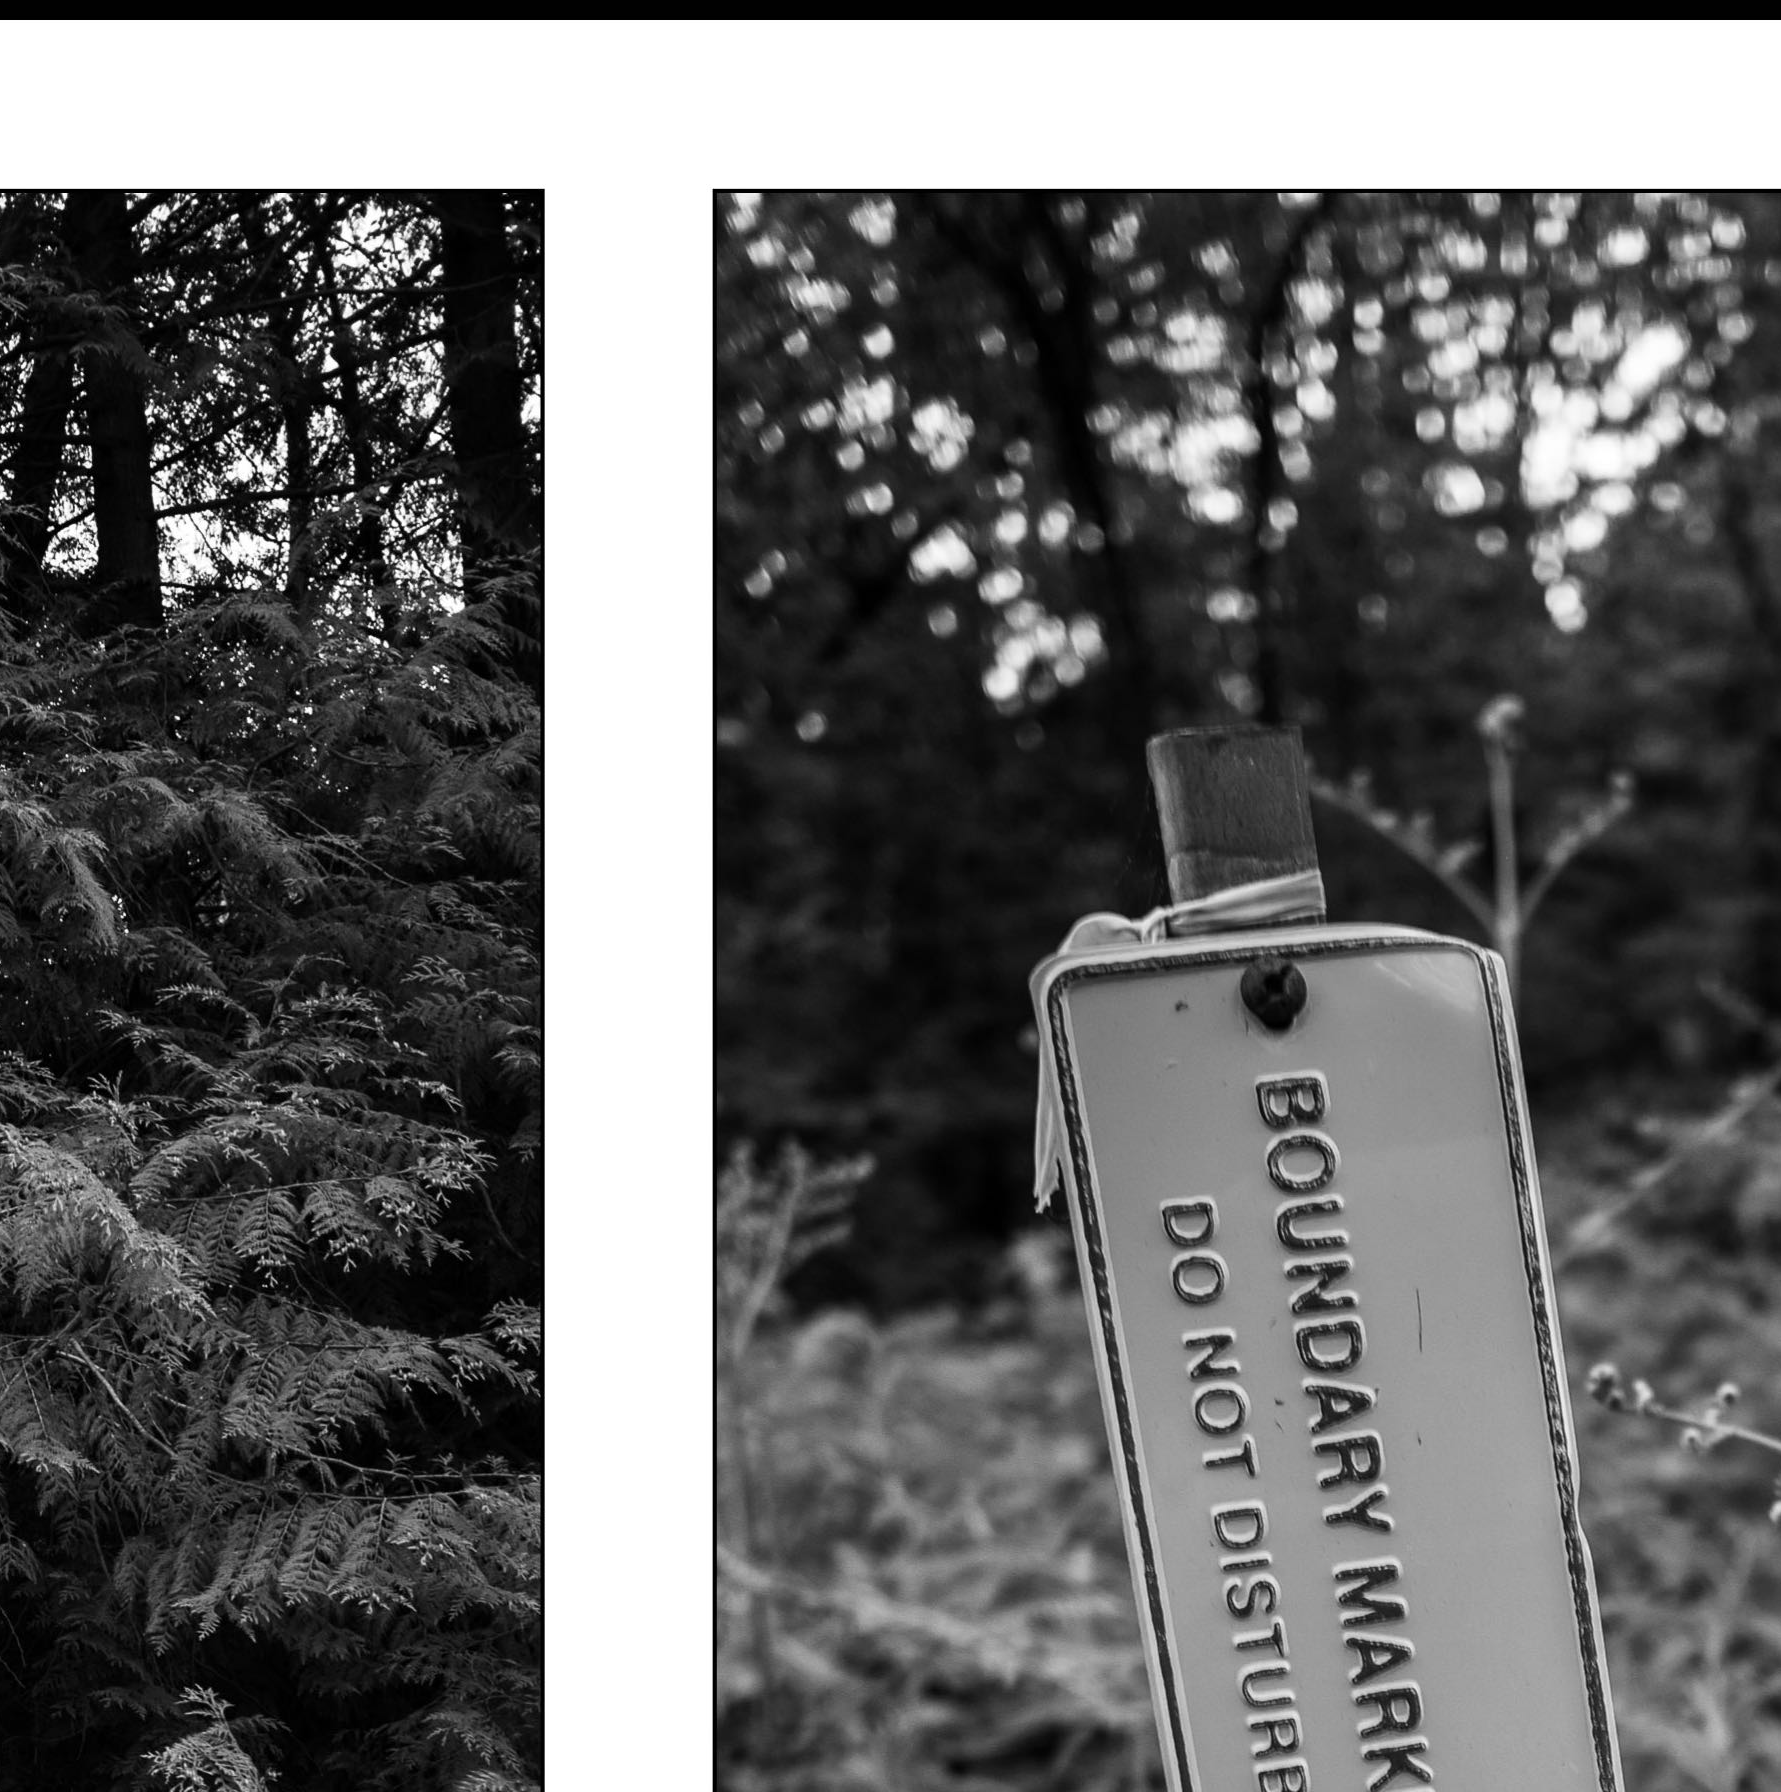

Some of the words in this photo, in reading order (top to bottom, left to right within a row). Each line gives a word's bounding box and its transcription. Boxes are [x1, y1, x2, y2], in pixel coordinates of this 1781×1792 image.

[1160, 1198, 1229, 1306] DO
[1256, 1071, 1394, 1532] BOUNDARY
[1183, 1327, 1260, 1478] NOT
